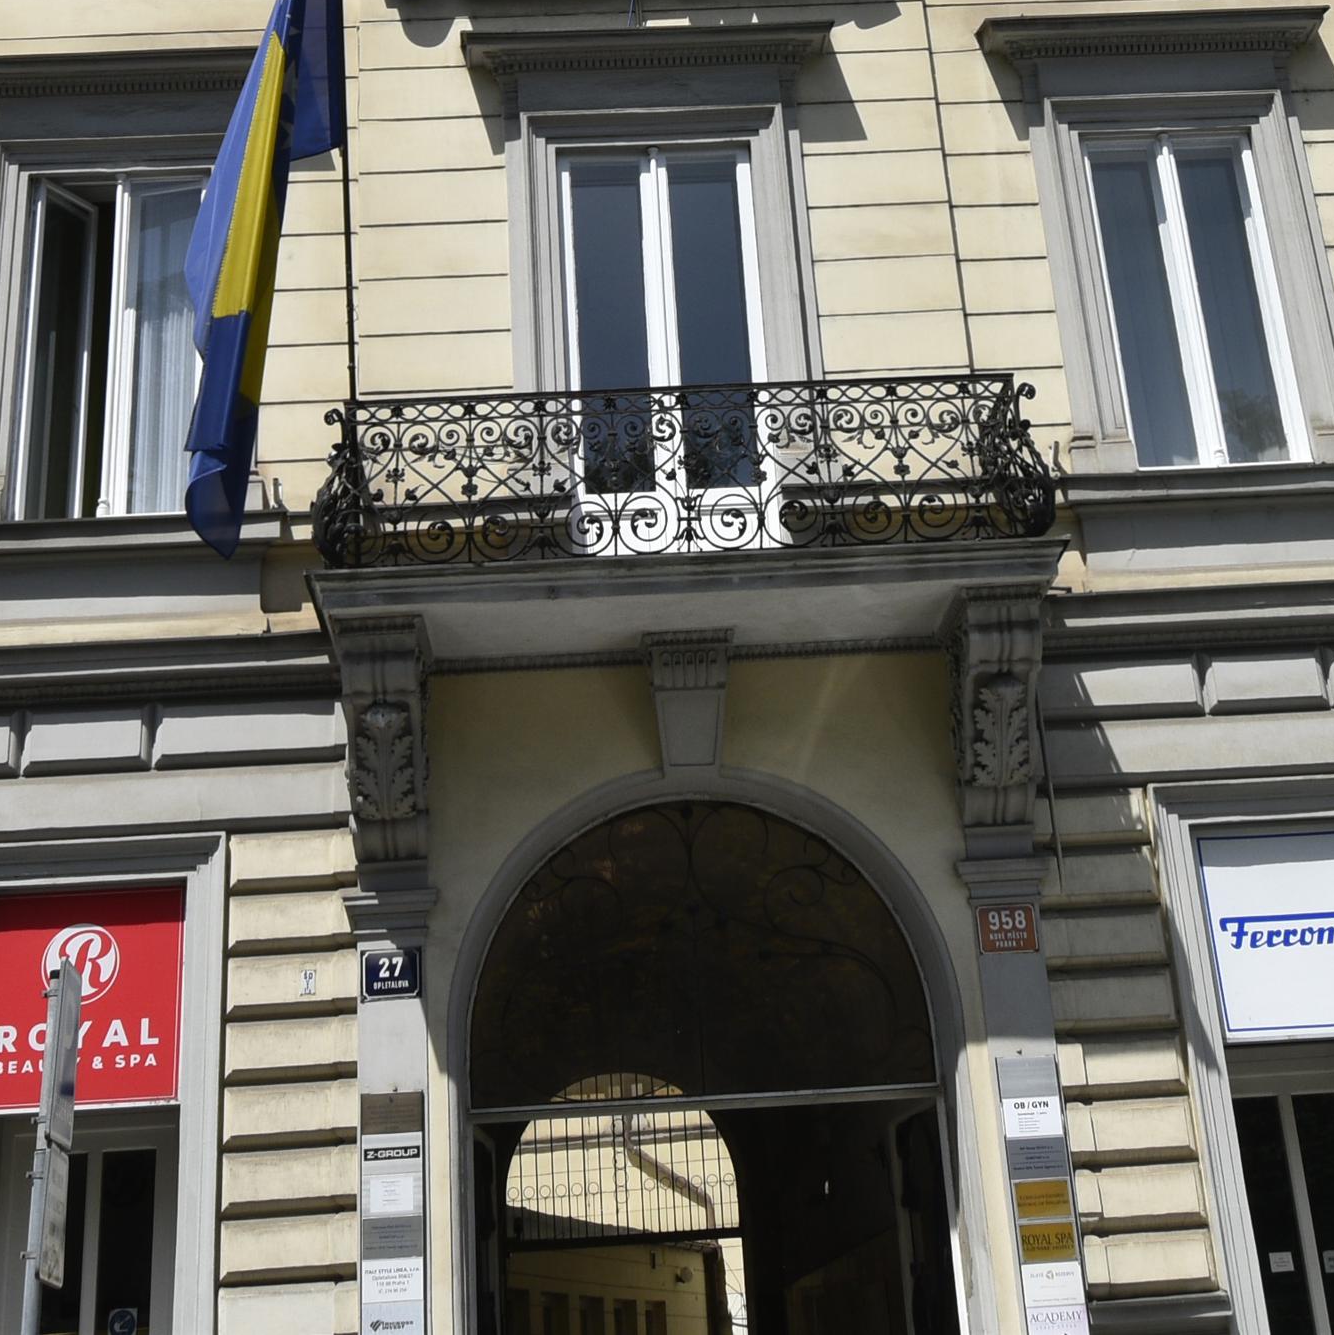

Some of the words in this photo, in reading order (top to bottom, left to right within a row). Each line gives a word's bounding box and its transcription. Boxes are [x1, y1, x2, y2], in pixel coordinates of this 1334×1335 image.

[988, 910, 1027, 930] 958
[378, 956, 404, 978] 27
[373, 980, 409, 990] OPLETALOVA
[91, 1055, 104, 1070] &
[114, 1053, 158, 1069] SPA
[1013, 1101, 1026, 1110] OB
[1031, 1100, 1049, 1109] GYN
[366, 1148, 418, 1159] Z-GROUP
[1021, 1233, 1051, 1245] ROYAL
[1054, 1232, 1075, 1244] SPA
[1029, 1309, 1082, 1325] ACADEMY
